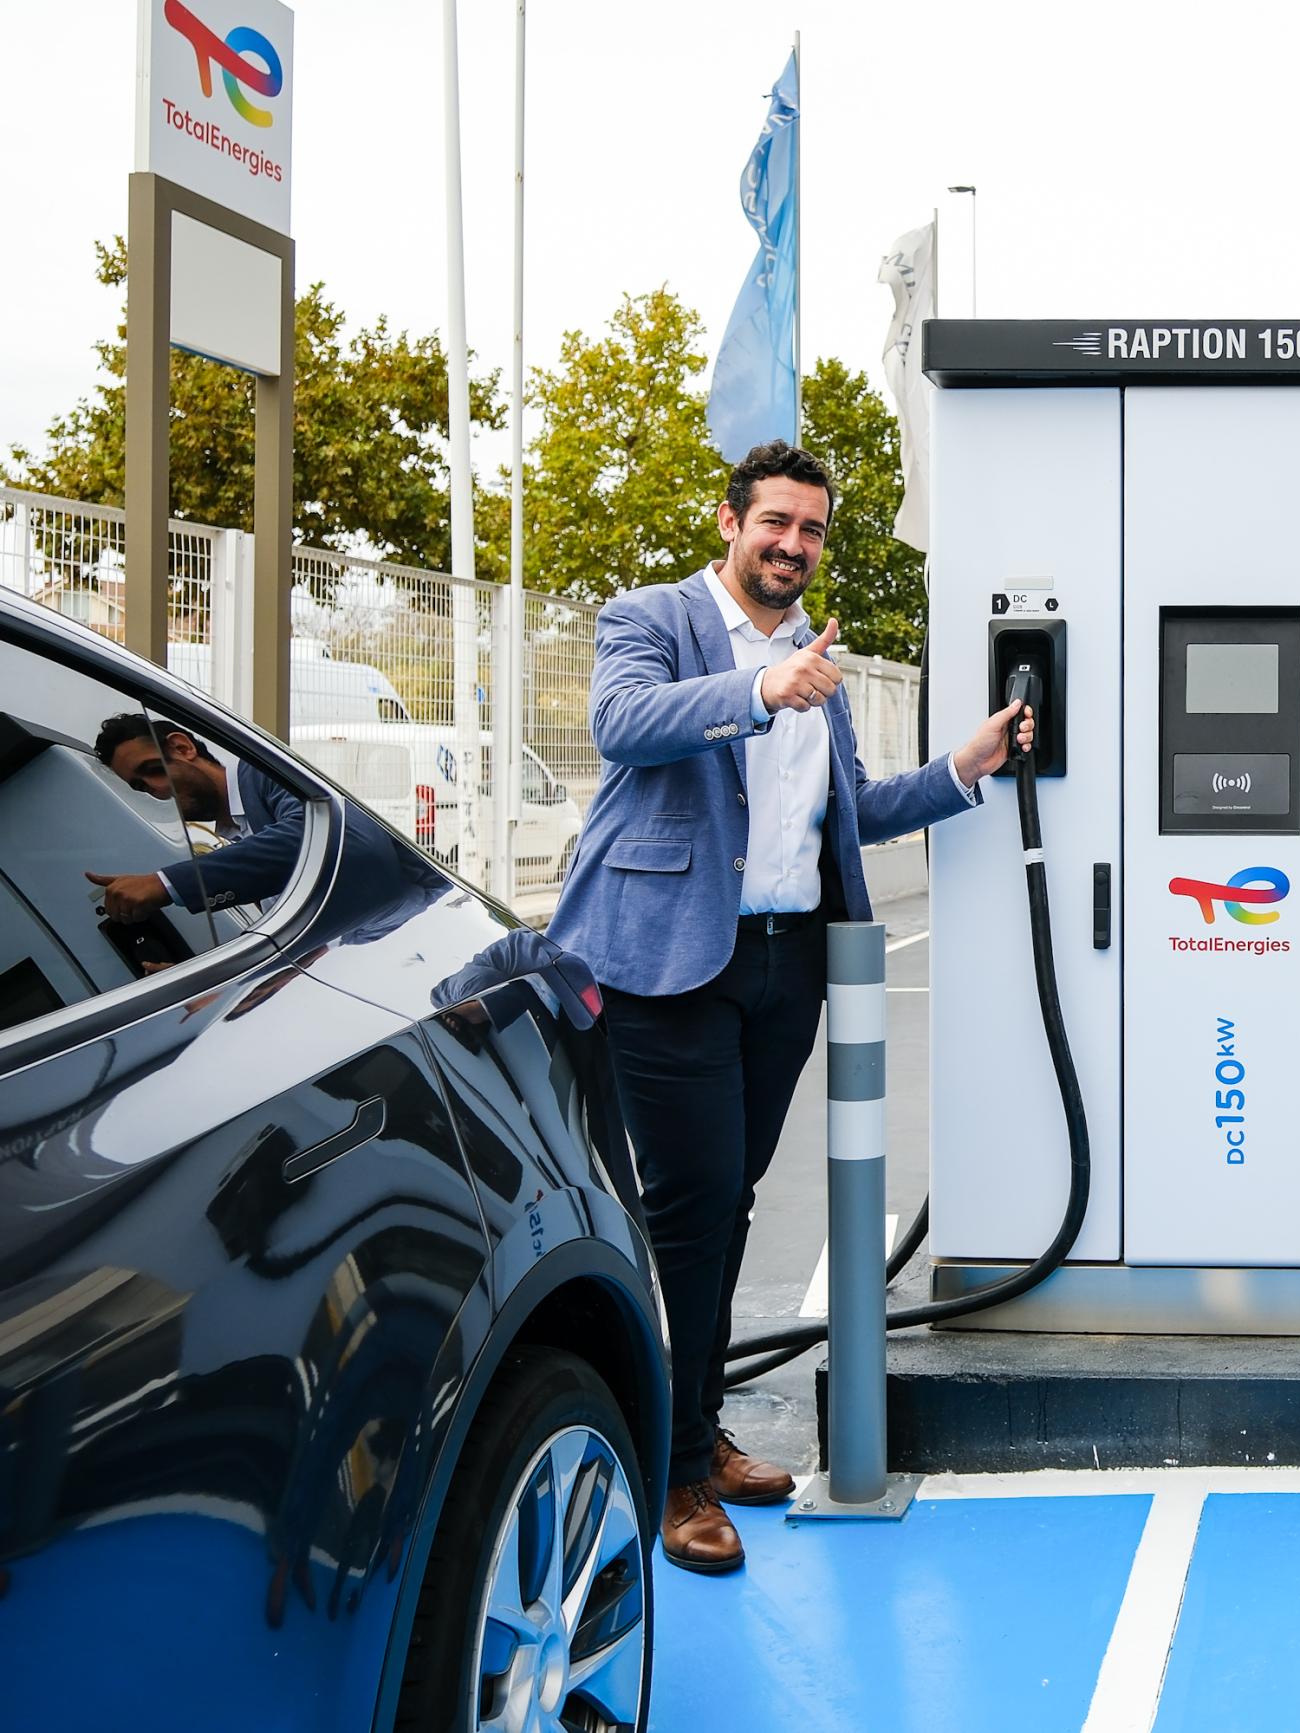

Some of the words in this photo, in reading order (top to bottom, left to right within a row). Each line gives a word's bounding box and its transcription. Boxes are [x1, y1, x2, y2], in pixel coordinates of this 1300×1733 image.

[162, 98, 283, 183] TotalEnergies
[1108, 328, 1247, 360] RAPTION
[996, 598, 1002, 610] 1
[1013, 594, 1028, 603] DC
[1168, 936, 1291, 956] TotalEnergies
